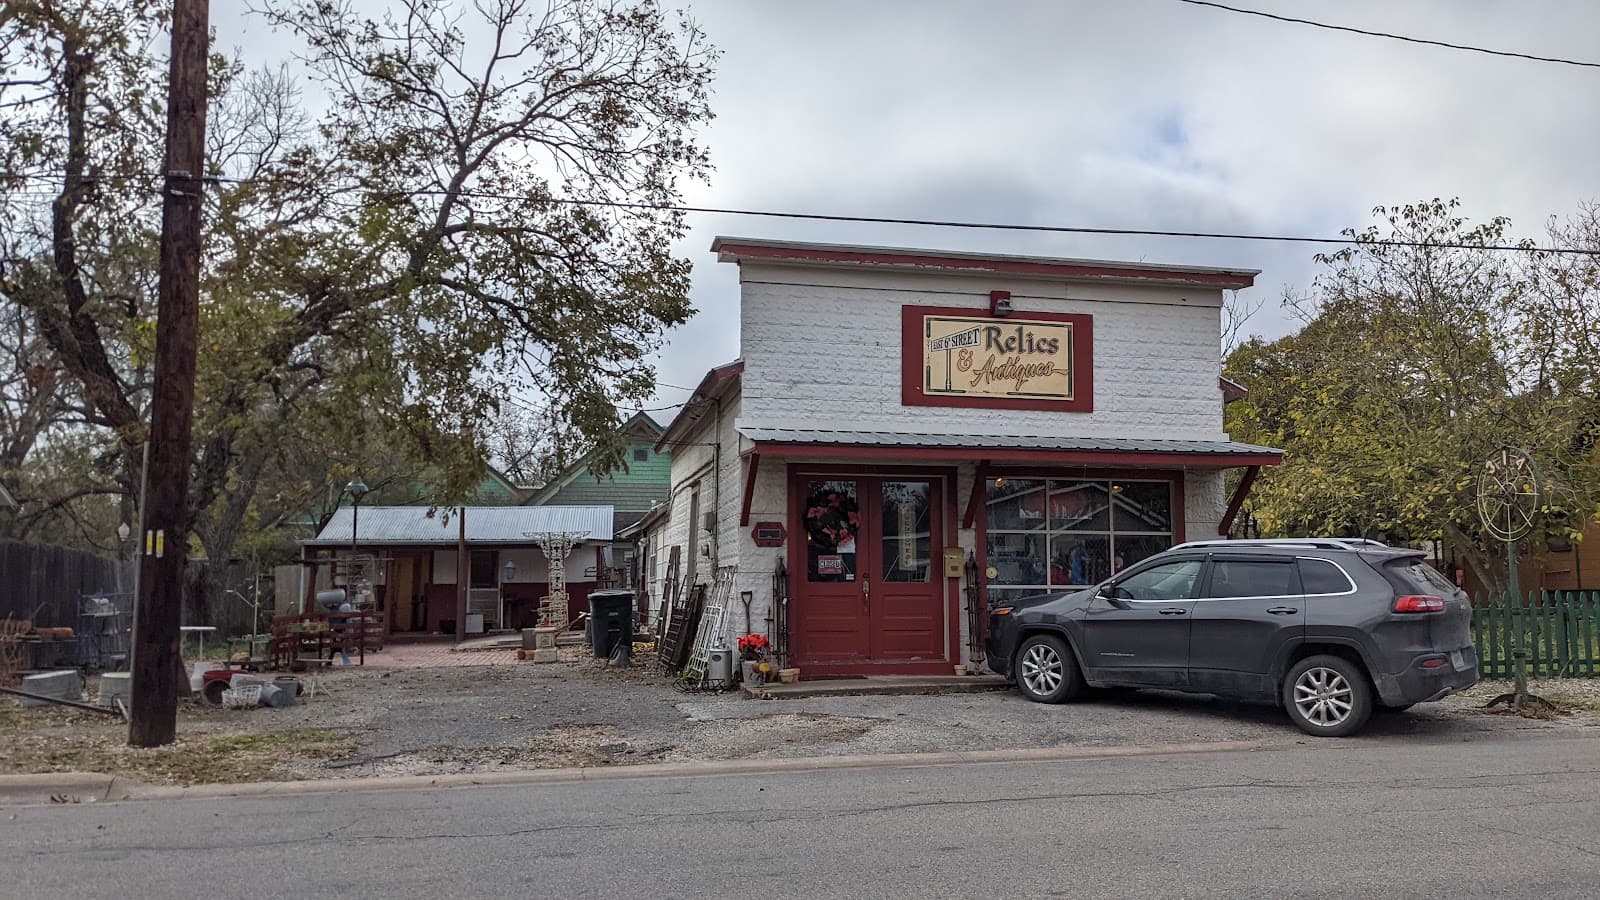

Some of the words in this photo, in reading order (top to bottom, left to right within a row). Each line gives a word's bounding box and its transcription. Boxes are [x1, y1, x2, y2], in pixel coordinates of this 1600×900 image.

[951, 328, 980, 347] STREET
[982, 325, 1060, 355] Relics
[957, 348, 974, 372] &
[970, 353, 1070, 391] Antiques
